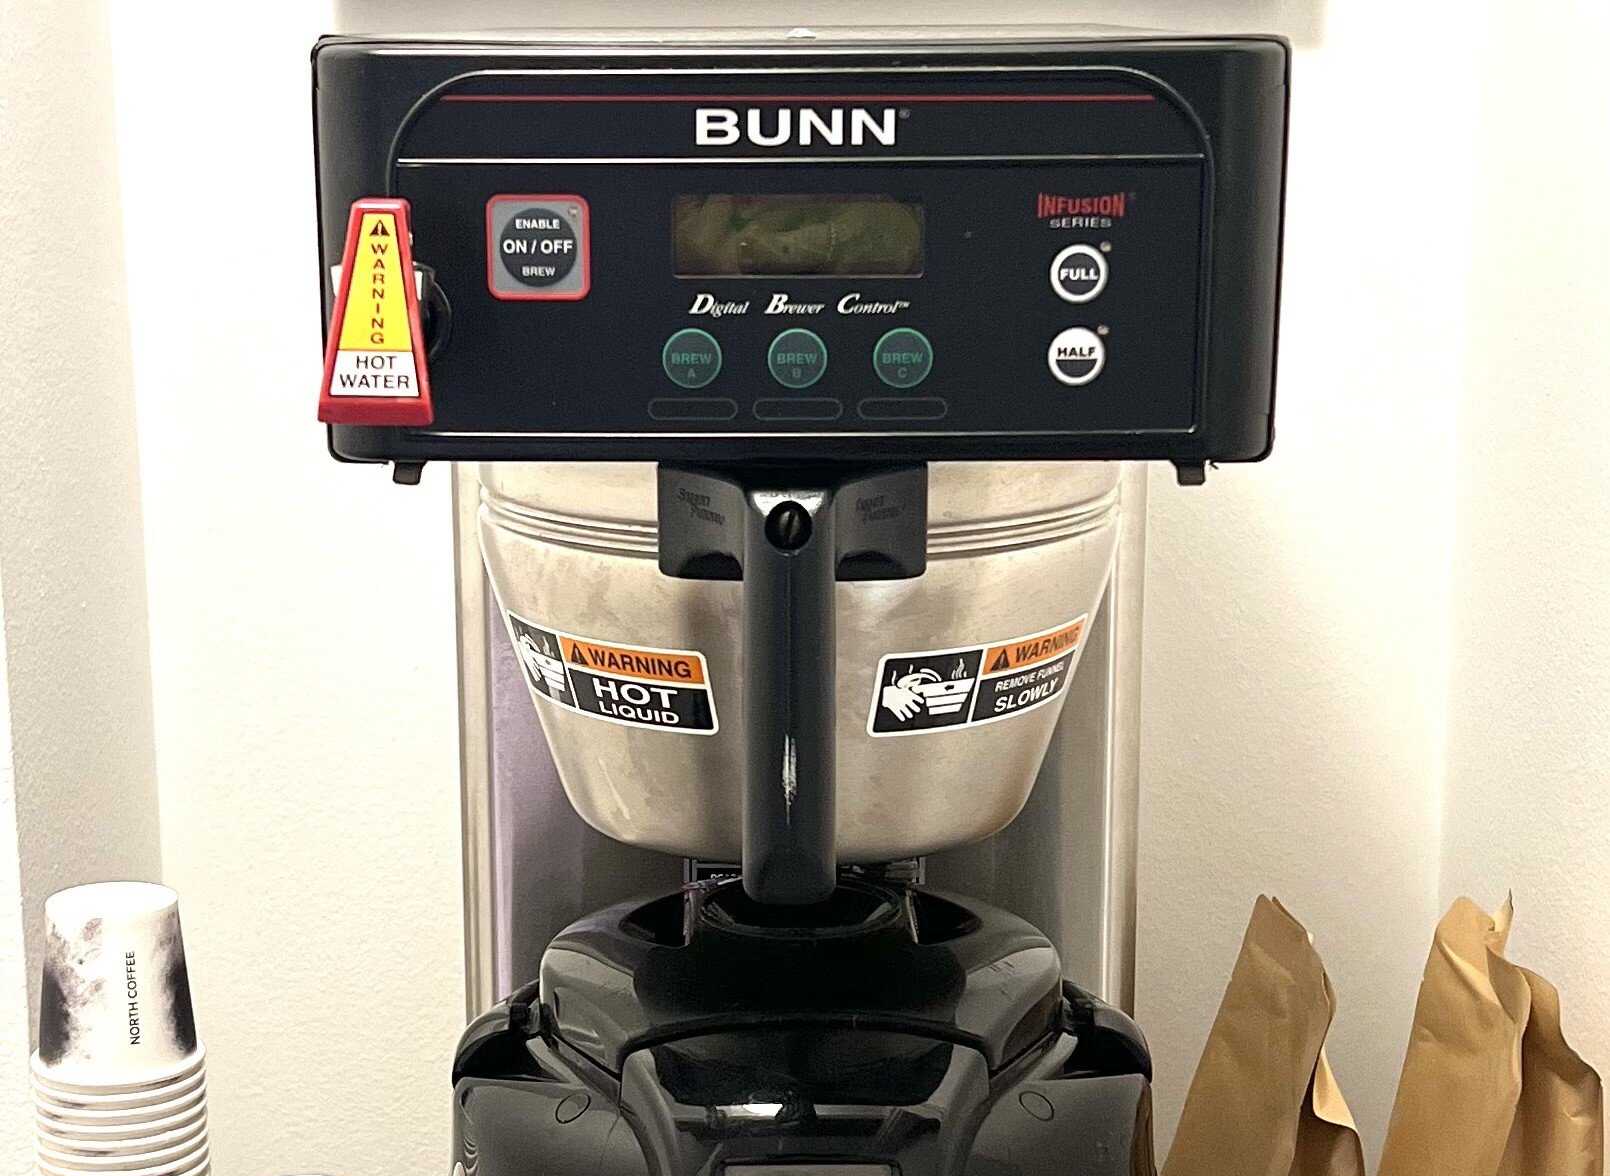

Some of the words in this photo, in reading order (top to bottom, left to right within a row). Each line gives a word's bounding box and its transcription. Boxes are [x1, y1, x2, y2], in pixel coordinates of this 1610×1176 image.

[694, 107, 897, 147] BUNN
[1037, 192, 1125, 219] INFUSION
[515, 218, 560, 230] ENABLE
[1050, 217, 1112, 229] SERIES
[522, 265, 556, 277] BREW
[1059, 267, 1099, 281] FULL
[370, 243, 388, 344] WARNING
[688, 293, 750, 317] Digital
[764, 293, 825, 315] Brewer
[356, 354, 398, 370] HOT
[671, 353, 713, 365] BREW
[776, 353, 819, 365] BREW
[881, 353, 923, 365] BREW
[1057, 346, 1097, 358] HALF
[339, 373, 410, 389] WATER
[898, 368, 907, 379] C
[1015, 626, 1080, 663] WARNING
[587, 647, 692, 679] WARNING
[592, 677, 678, 709] HOT
[995, 671, 1038, 693] REMOVE
[994, 677, 1059, 713] SLOWLY
[598, 701, 680, 725] LIQUID
[125, 951, 138, 999] COFFEE
[129, 1002, 141, 1045] NORTH
